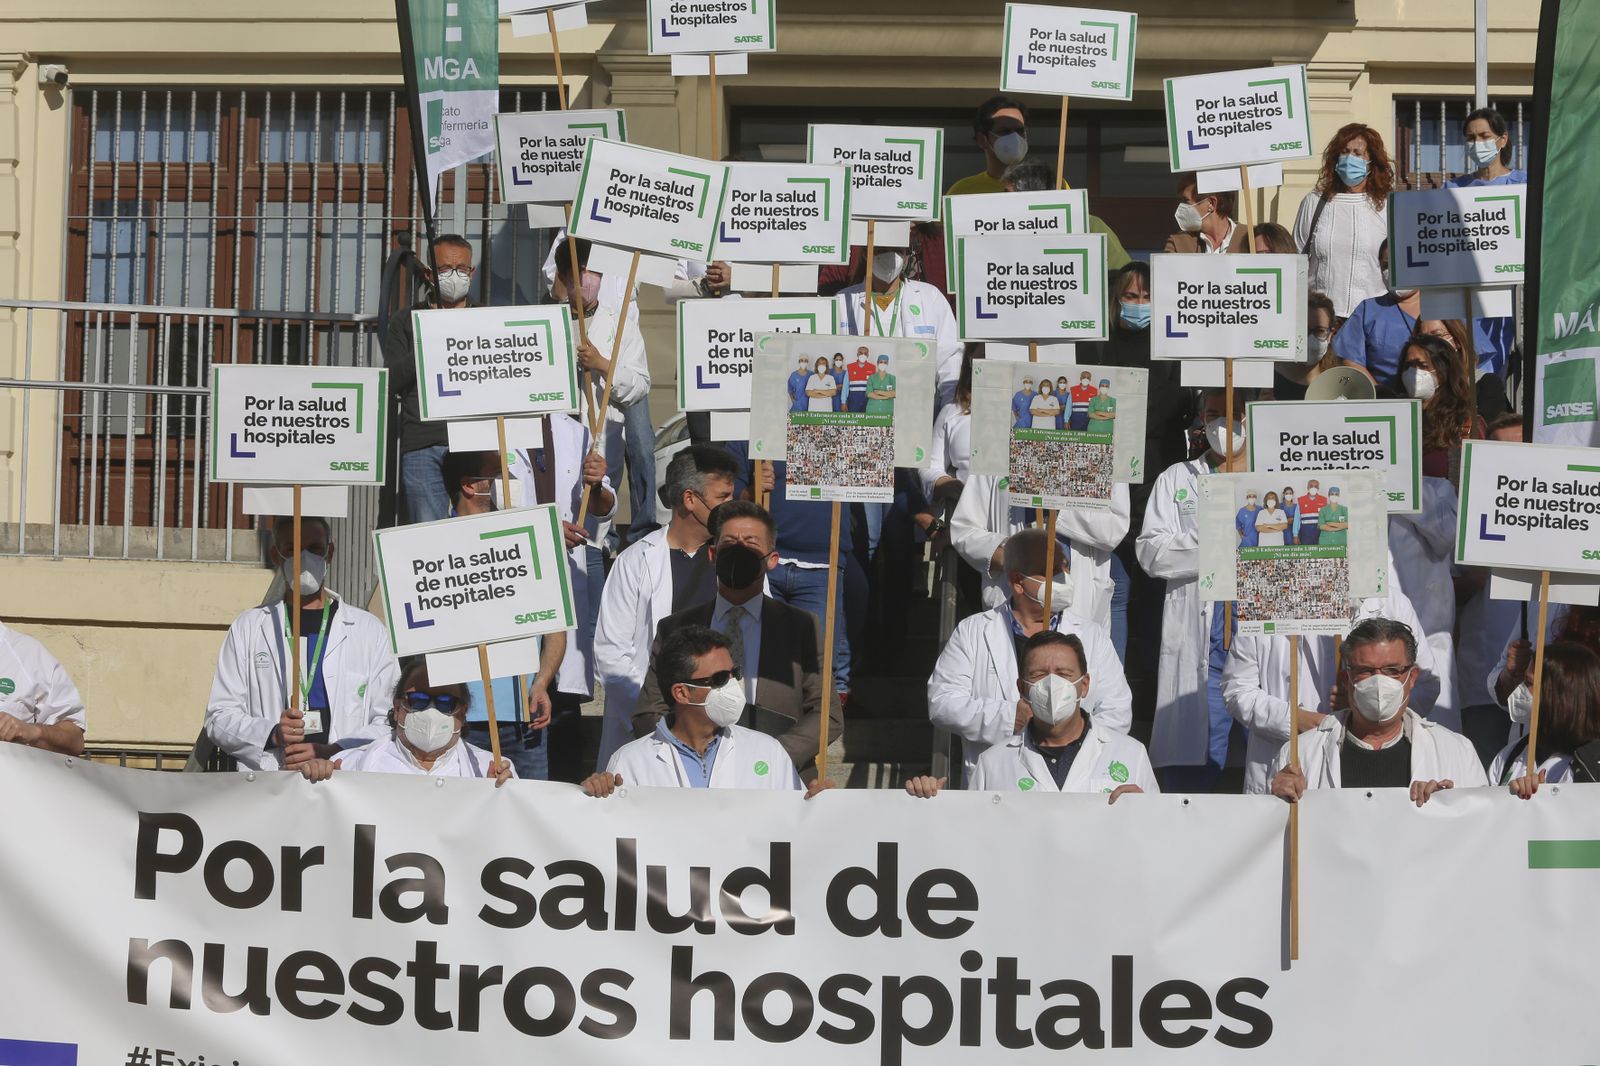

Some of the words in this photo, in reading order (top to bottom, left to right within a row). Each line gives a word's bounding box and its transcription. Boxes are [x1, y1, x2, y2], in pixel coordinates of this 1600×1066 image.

[670, 2, 687, 13] de
[690, 2, 747, 12] nuestros
[671, 13, 737, 27] hospitales
[1030, 28, 1052, 40] Por
[1056, 30, 1066, 41] la
[1070, 32, 1105, 44] salud
[1029, 40, 1046, 52] de
[1050, 42, 1107, 58] nuestros
[1028, 52, 1097, 68] hospitales
[1092, 81, 1120, 89] SATSE
[1196, 99, 1220, 110] Por
[1223, 96, 1236, 108] la
[1239, 91, 1278, 106] salud
[1197, 112, 1216, 124] de
[1219, 104, 1282, 122] nuestros
[1197, 120, 1272, 138] hospitales
[520, 137, 542, 148] Por
[545, 136, 557, 147] la
[560, 135, 586, 146] salu
[1270, 141, 1302, 151] SATSE
[521, 149, 538, 160] de
[541, 148, 584, 160] nuestr
[834, 148, 856, 159] Por
[860, 148, 871, 160] la
[874, 150, 911, 162] salud
[522, 160, 582, 176] hospitale
[854, 163, 913, 177] nuestros
[609, 168, 636, 189] Por
[638, 174, 650, 188] la
[654, 180, 694, 199] salud
[606, 183, 626, 200] de
[629, 187, 694, 213] nuestros
[732, 190, 757, 202] Por
[760, 190, 772, 202] la
[776, 190, 816, 202] salud
[603, 197, 680, 223] hospitales
[731, 204, 750, 216] de
[754, 205, 819, 218] nuestros
[897, 202, 927, 210] SATSE
[975, 220, 999, 231] Por
[1002, 218, 1015, 230] la
[1018, 216, 1058, 230] salud
[1418, 213, 1443, 225] Por
[1447, 211, 1460, 223] la
[1464, 208, 1506, 222] salud
[731, 217, 806, 233] hospitales
[1417, 226, 1438, 239] de
[1442, 224, 1510, 238] nuestros
[671, 239, 703, 252] SATSE
[1418, 238, 1498, 256] hospitales
[988, 262, 1012, 275] Por
[1016, 262, 1029, 275] la
[1033, 262, 1074, 275] salud
[987, 277, 1007, 290] de
[1010, 278, 1078, 290] nuestros
[1178, 282, 1204, 294] Por
[1208, 281, 1221, 294] la
[1225, 282, 1267, 294] salud
[988, 292, 1065, 308] hospitales
[1177, 296, 1198, 309] de
[1202, 297, 1270, 309] nuestros
[1061, 320, 1095, 329] SATSE
[1178, 311, 1258, 327] hospitales
[1554, 303, 1600, 339] MÁ
[446, 338, 473, 351] Por
[477, 336, 491, 349] la
[495, 333, 538, 348] salud
[708, 330, 736, 343] Por
[740, 328, 753, 342] la
[708, 345, 730, 358] de
[1254, 340, 1288, 348] SATSE
[448, 353, 468, 366] de
[472, 350, 542, 366] nuestros
[449, 365, 531, 384] hospitales
[709, 360, 752, 377] hospi
[245, 396, 275, 410] Por
[279, 396, 294, 411] la
[298, 397, 346, 412] salud
[529, 392, 564, 402] SATSE
[1547, 402, 1593, 418] SATSE
[244, 412, 268, 426] de
[272, 414, 350, 428] nuestros
[244, 428, 335, 447] hospitales
[1280, 432, 1309, 446] Por
[1314, 432, 1328, 445] la
[1332, 430, 1380, 445] salud
[1280, 448, 1303, 462] de
[1307, 447, 1384, 461] nuestros
[330, 462, 369, 471] SATSE
[1497, 475, 1528, 491] Por
[1532, 477, 1547, 493] la
[1552, 480, 1600, 497] salud
[1496, 492, 1520, 508] de
[1494, 509, 1590, 531] hospitales
[413, 560, 444, 575] Por
[448, 554, 466, 570] la
[470, 544, 522, 568] salud
[416, 576, 440, 592] de
[445, 564, 528, 591] nuestros
[417, 581, 515, 611] hospitales
[515, 609, 556, 624] SATSE
[134, 810, 325, 912] Por
[352, 824, 448, 925] la
[478, 838, 795, 936] salud
[826, 842, 979, 939] de
[127, 938, 637, 1039] nuestros
[670, 945, 1273, 1066] hospitales
